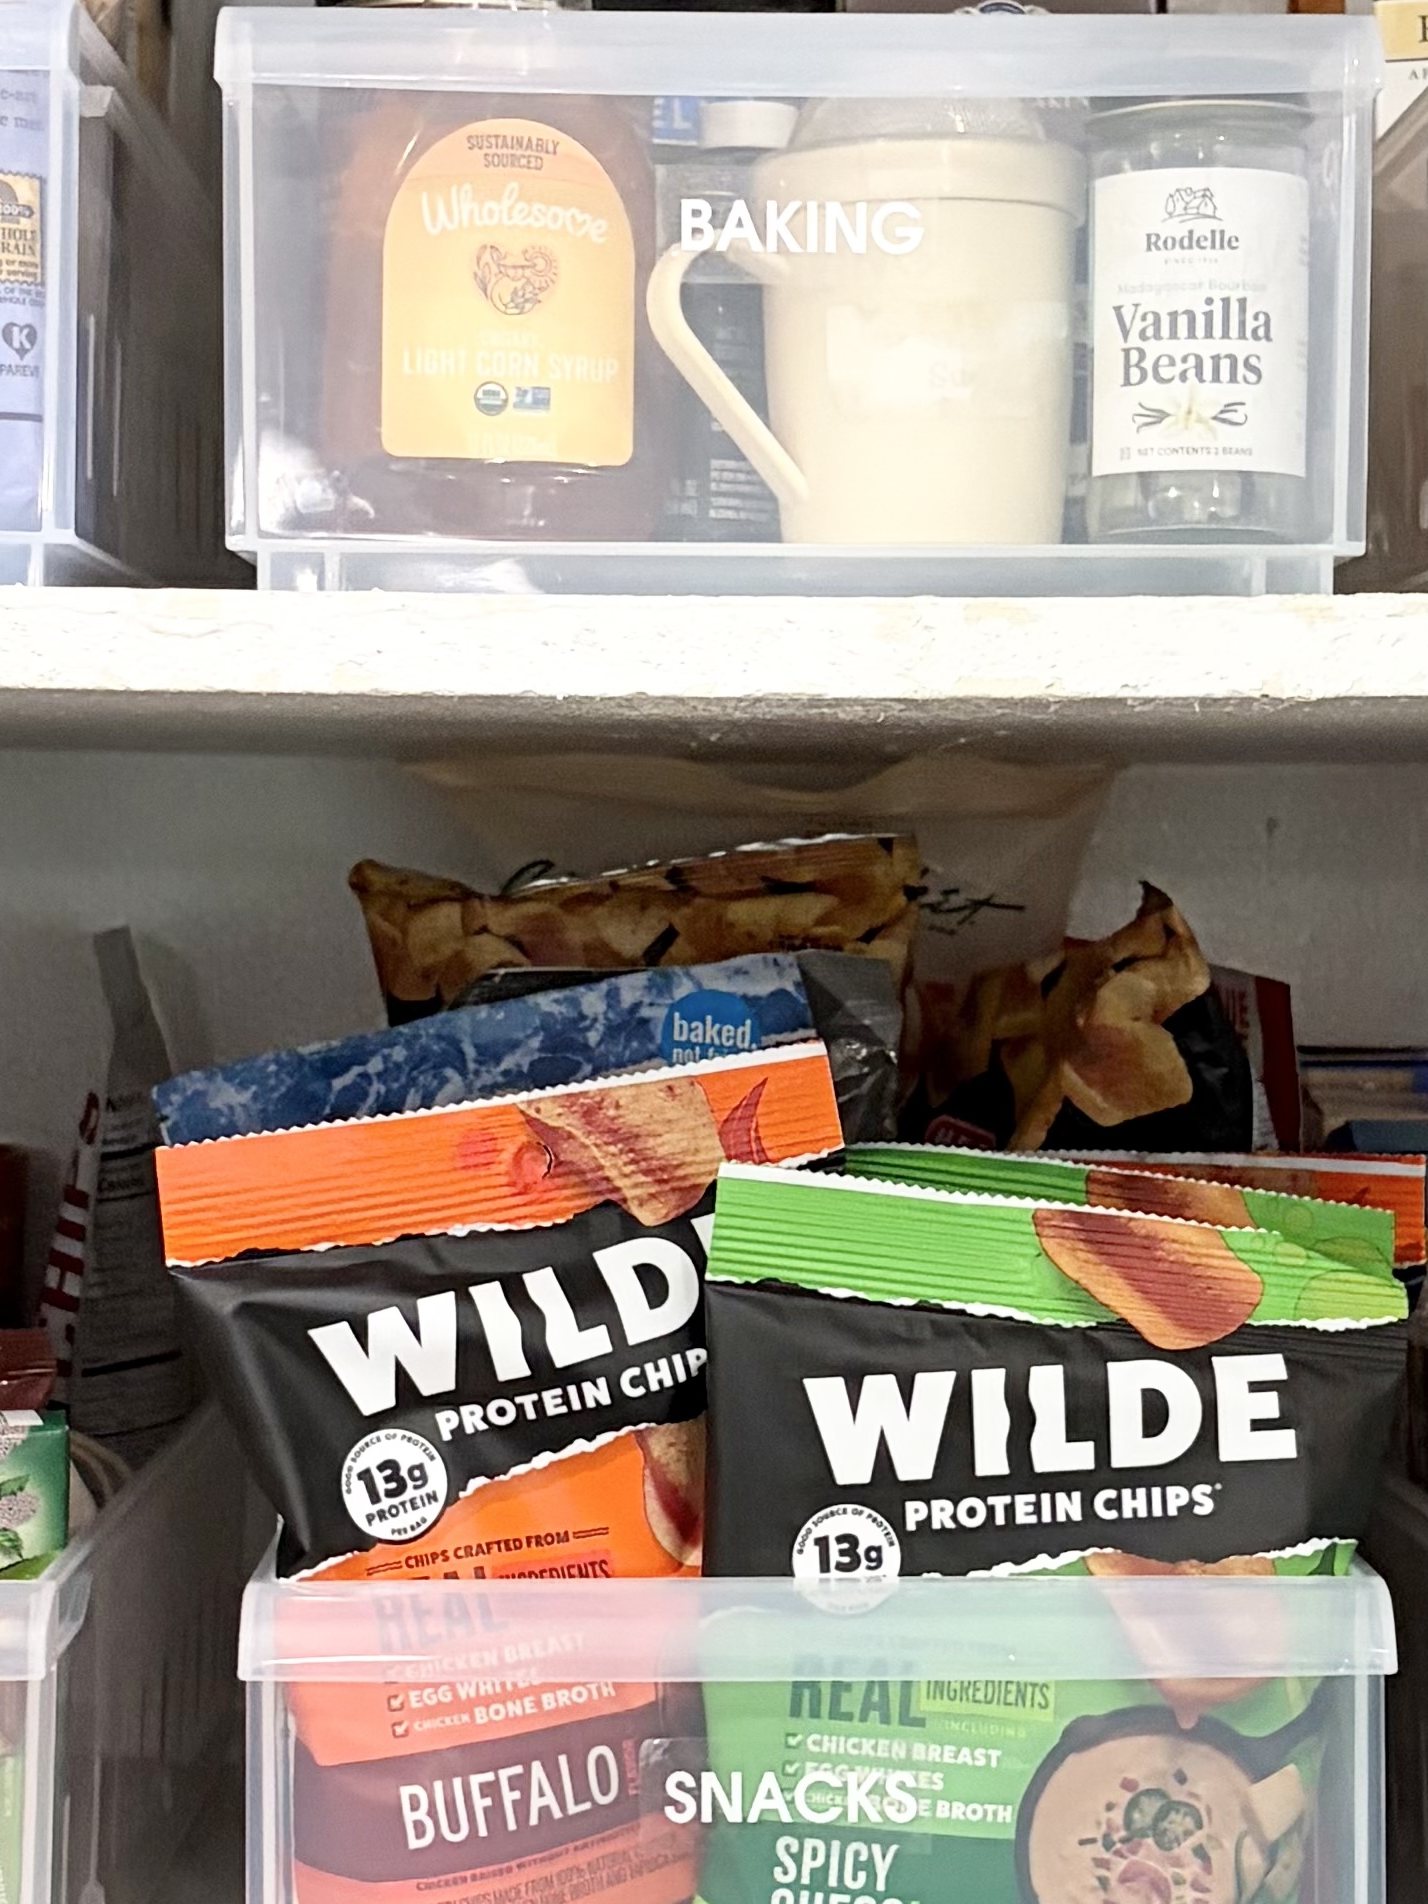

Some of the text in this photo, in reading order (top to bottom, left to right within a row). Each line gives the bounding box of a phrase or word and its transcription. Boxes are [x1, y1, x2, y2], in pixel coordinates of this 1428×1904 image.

[422, 181, 609, 244] Wholesome
[681, 199, 925, 255] BAKING
[1145, 230, 1240, 252] Rodelle
[1113, 296, 1273, 342] Vanilla
[1120, 346, 1263, 388] Beans
[671, 1011, 758, 1051] baked.
[308, 1215, 717, 1416] WILD
[435, 1378, 611, 1441] PROTEIN
[803, 1354, 1297, 1485] WILDE
[357, 1459, 429, 1506] 13g
[366, 1491, 439, 1526] PROTEIN
[905, 1483, 1215, 1532] PROTEIN CHIPS
[405, 1530, 569, 1570] CHIPS CRAFTED FROM
[813, 1535, 883, 1574] 13g
[475, 1681, 616, 1725] BONE BROTH
[926, 1678, 1050, 1711] INGREDIENTS
[806, 1734, 1001, 1767] CHICKEN BREAST
[400, 1744, 618, 1850] BUFFALO
[663, 1771, 918, 1825] SNACKS
[773, 1835, 899, 1890] SPICY
